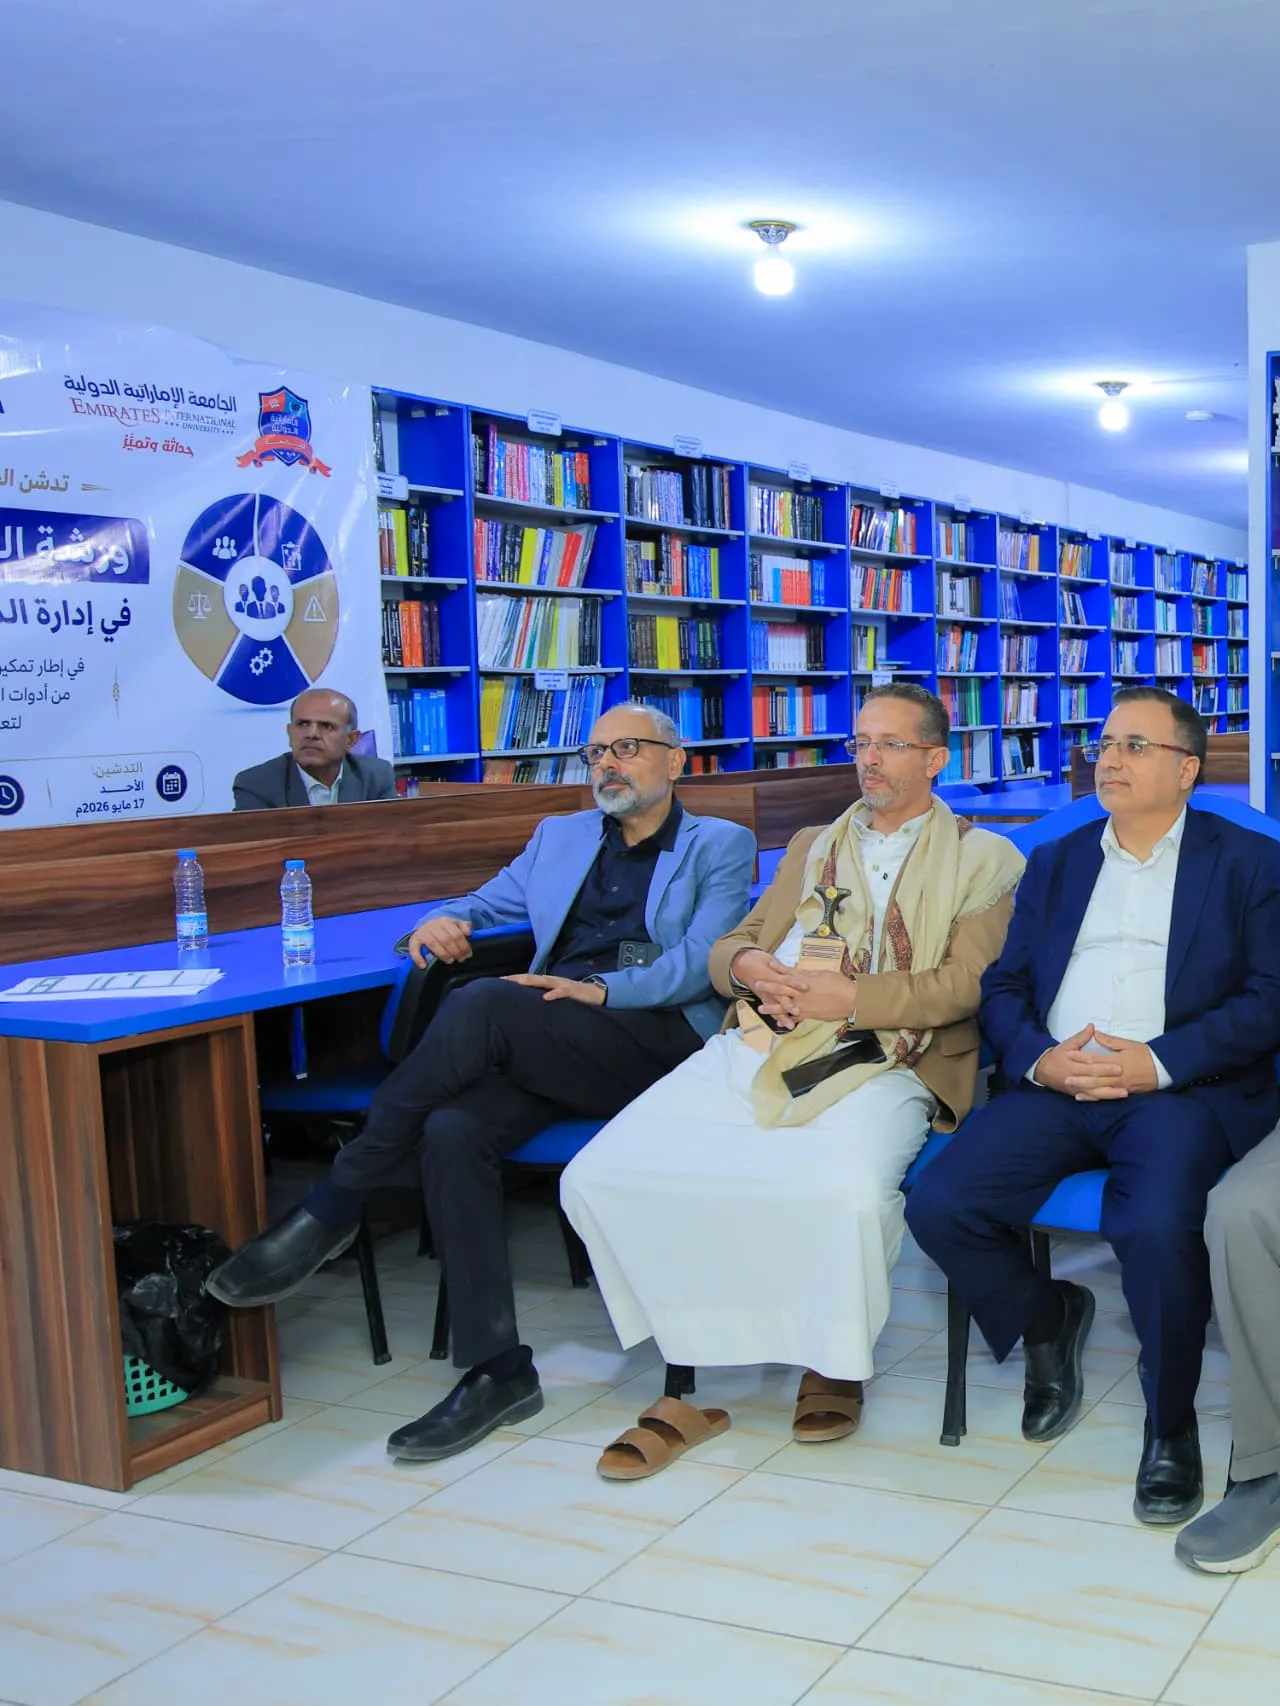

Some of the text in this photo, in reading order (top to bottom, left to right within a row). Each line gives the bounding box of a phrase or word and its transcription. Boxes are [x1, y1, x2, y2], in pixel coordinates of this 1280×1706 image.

[64, 375, 237, 414] الجامعة الإماراتية الدولية
[69, 397, 161, 427] EMIRATES
[162, 437, 194, 457] حداثة
[19, 470, 70, 493] تدشن
[36, 525, 130, 575] ورشة
[34, 598, 94, 635] إدارة
[100, 598, 132, 642] في
[36, 657, 64, 678] إطار
[67, 657, 85, 681] في
[9, 682, 48, 706] أدوات
[51, 690, 70, 705] من
[75, 798, 145, 817] 17 مايو 2026م
